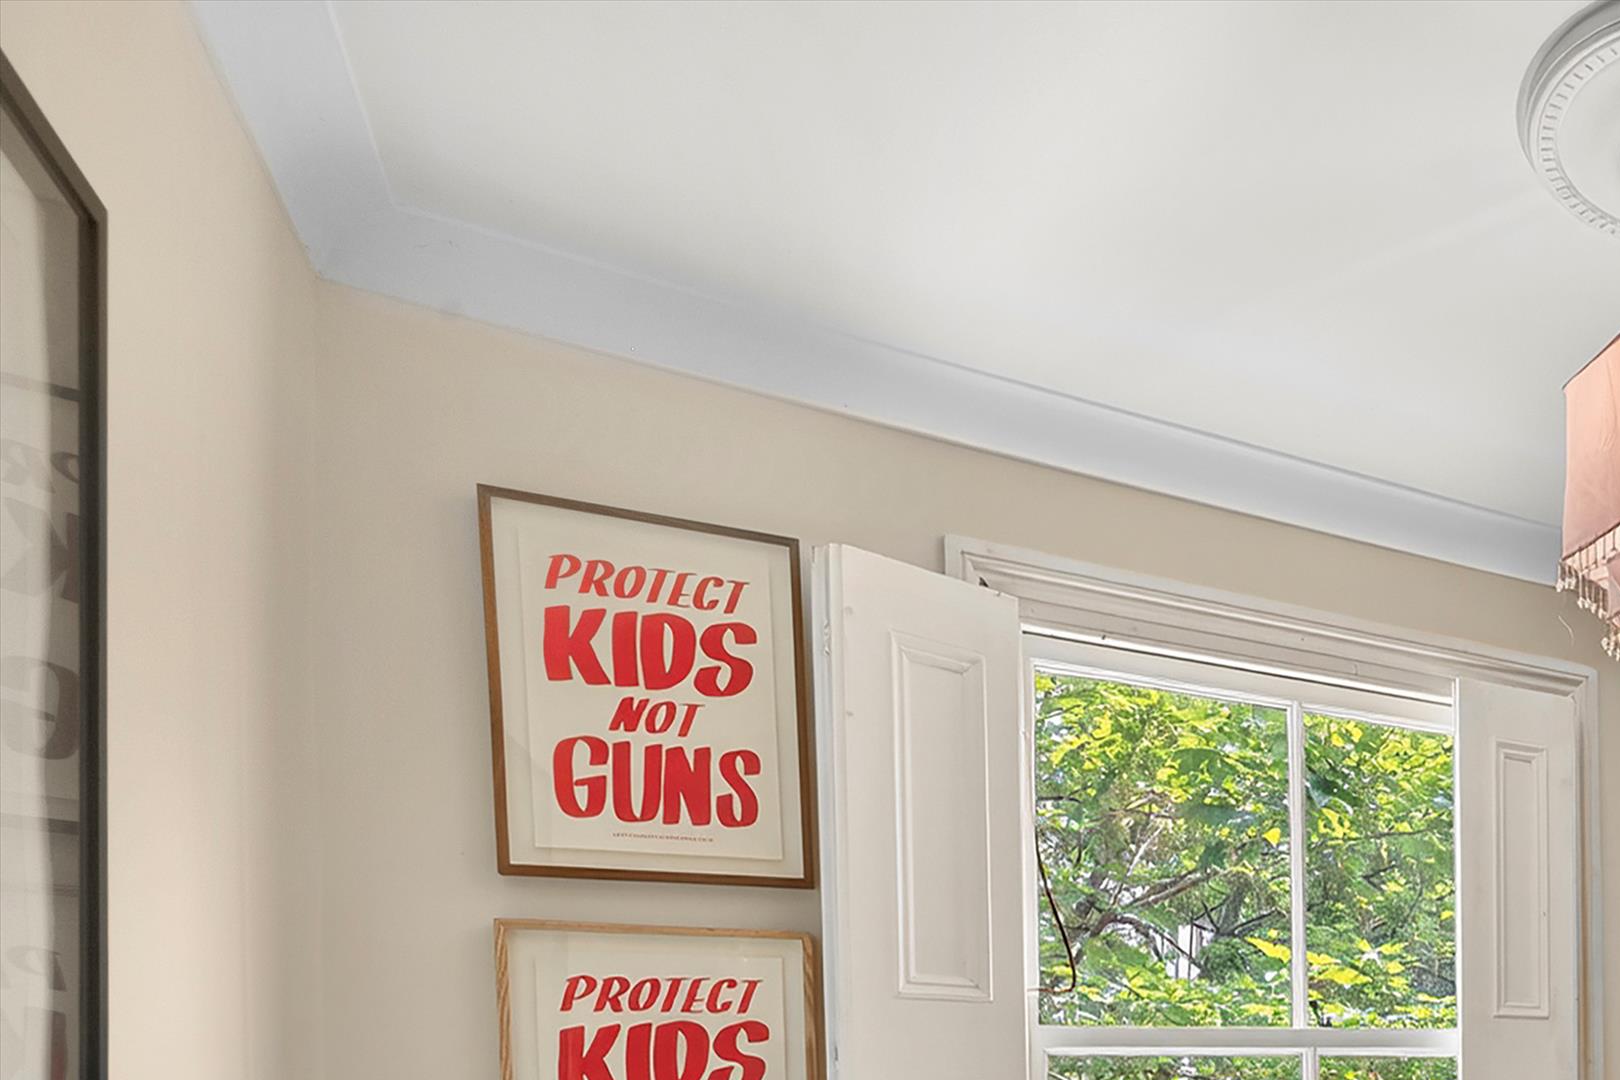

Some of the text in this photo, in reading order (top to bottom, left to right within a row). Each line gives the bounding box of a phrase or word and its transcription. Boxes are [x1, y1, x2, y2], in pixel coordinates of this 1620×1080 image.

[545, 552, 749, 614] PROTECT
[543, 605, 758, 698] KIDS
[608, 695, 706, 738] NOT
[552, 735, 761, 829] GUNS
[559, 976, 762, 1015] PROTECT
